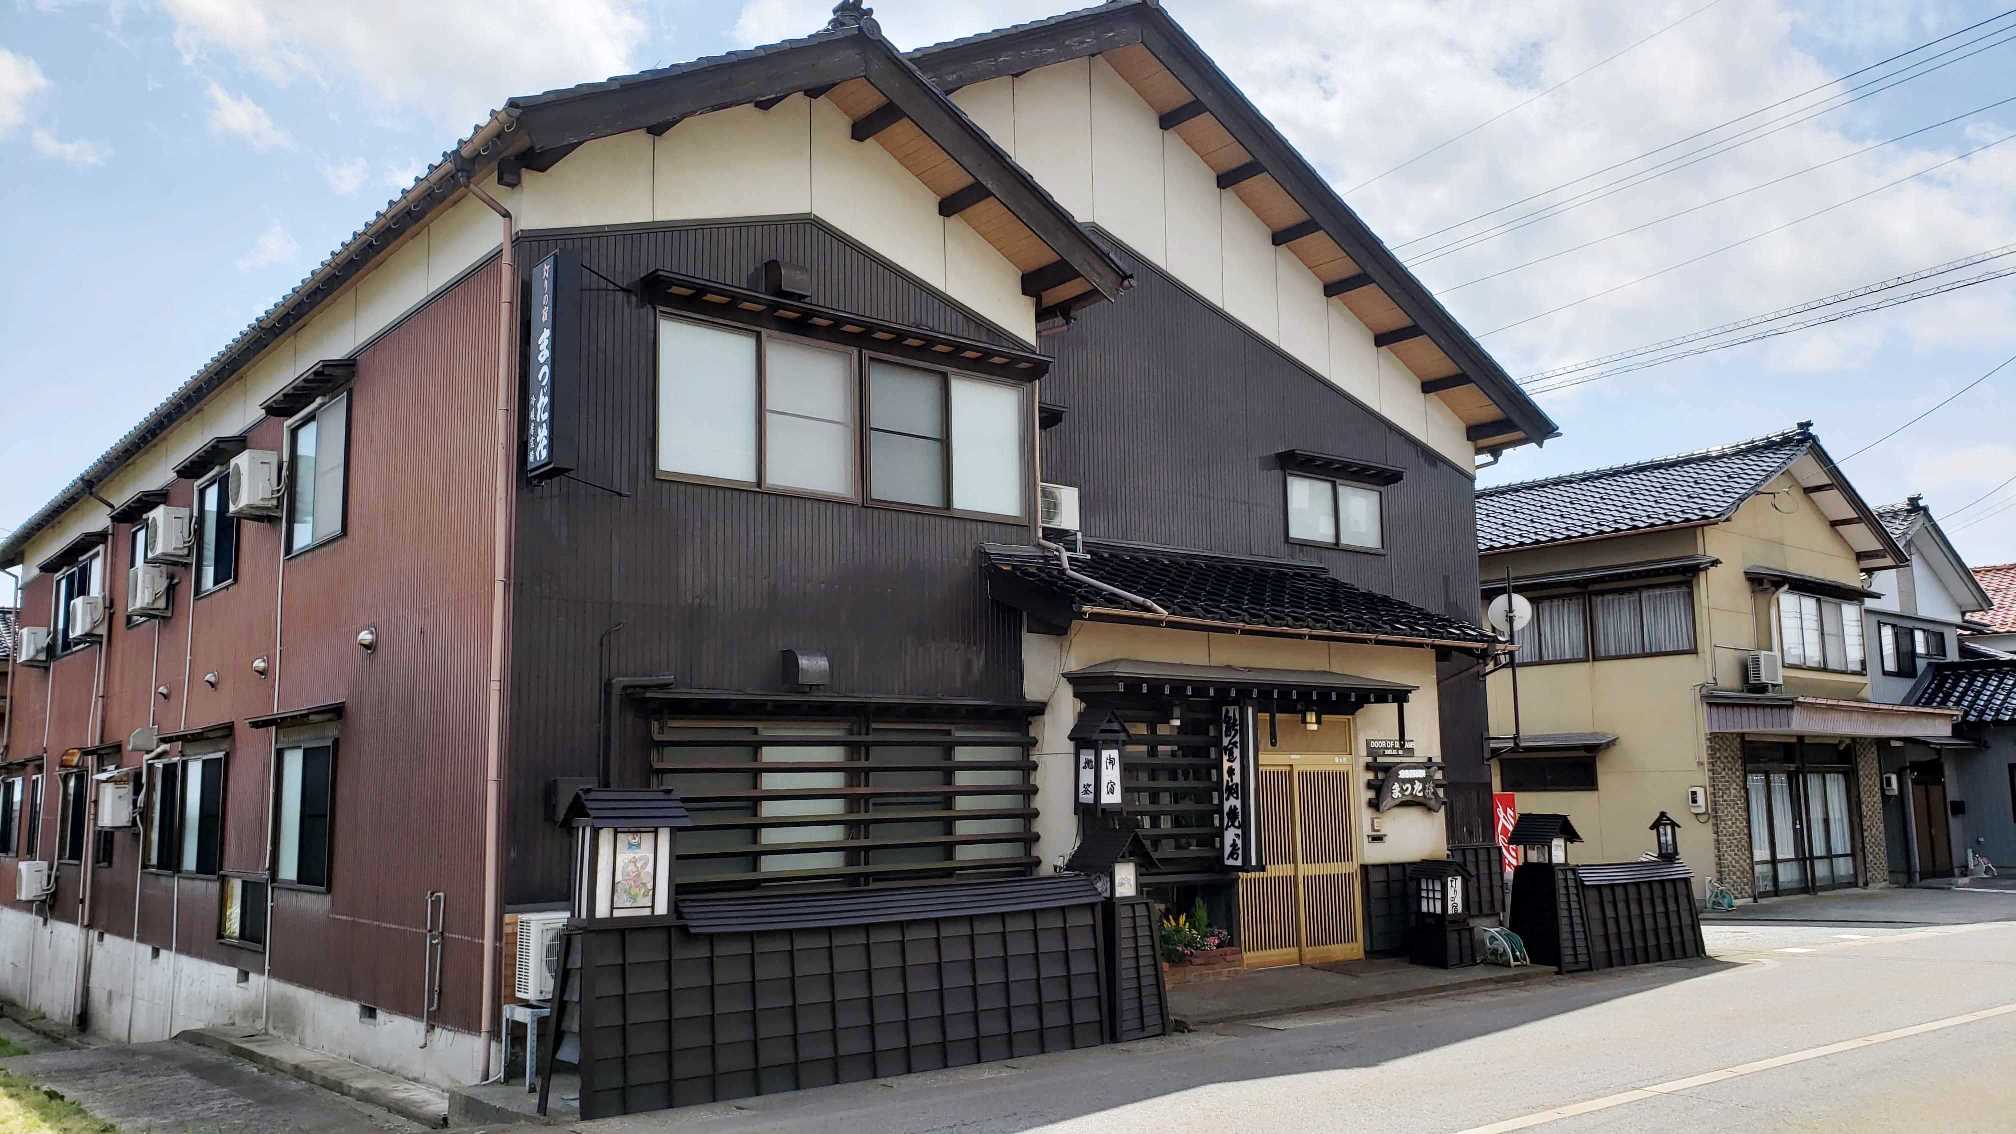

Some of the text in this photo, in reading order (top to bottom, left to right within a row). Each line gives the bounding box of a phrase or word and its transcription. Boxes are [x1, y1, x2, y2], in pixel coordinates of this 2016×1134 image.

[536, 327, 551, 461] まつだ荘
[1370, 740, 1387, 748] DOOR
